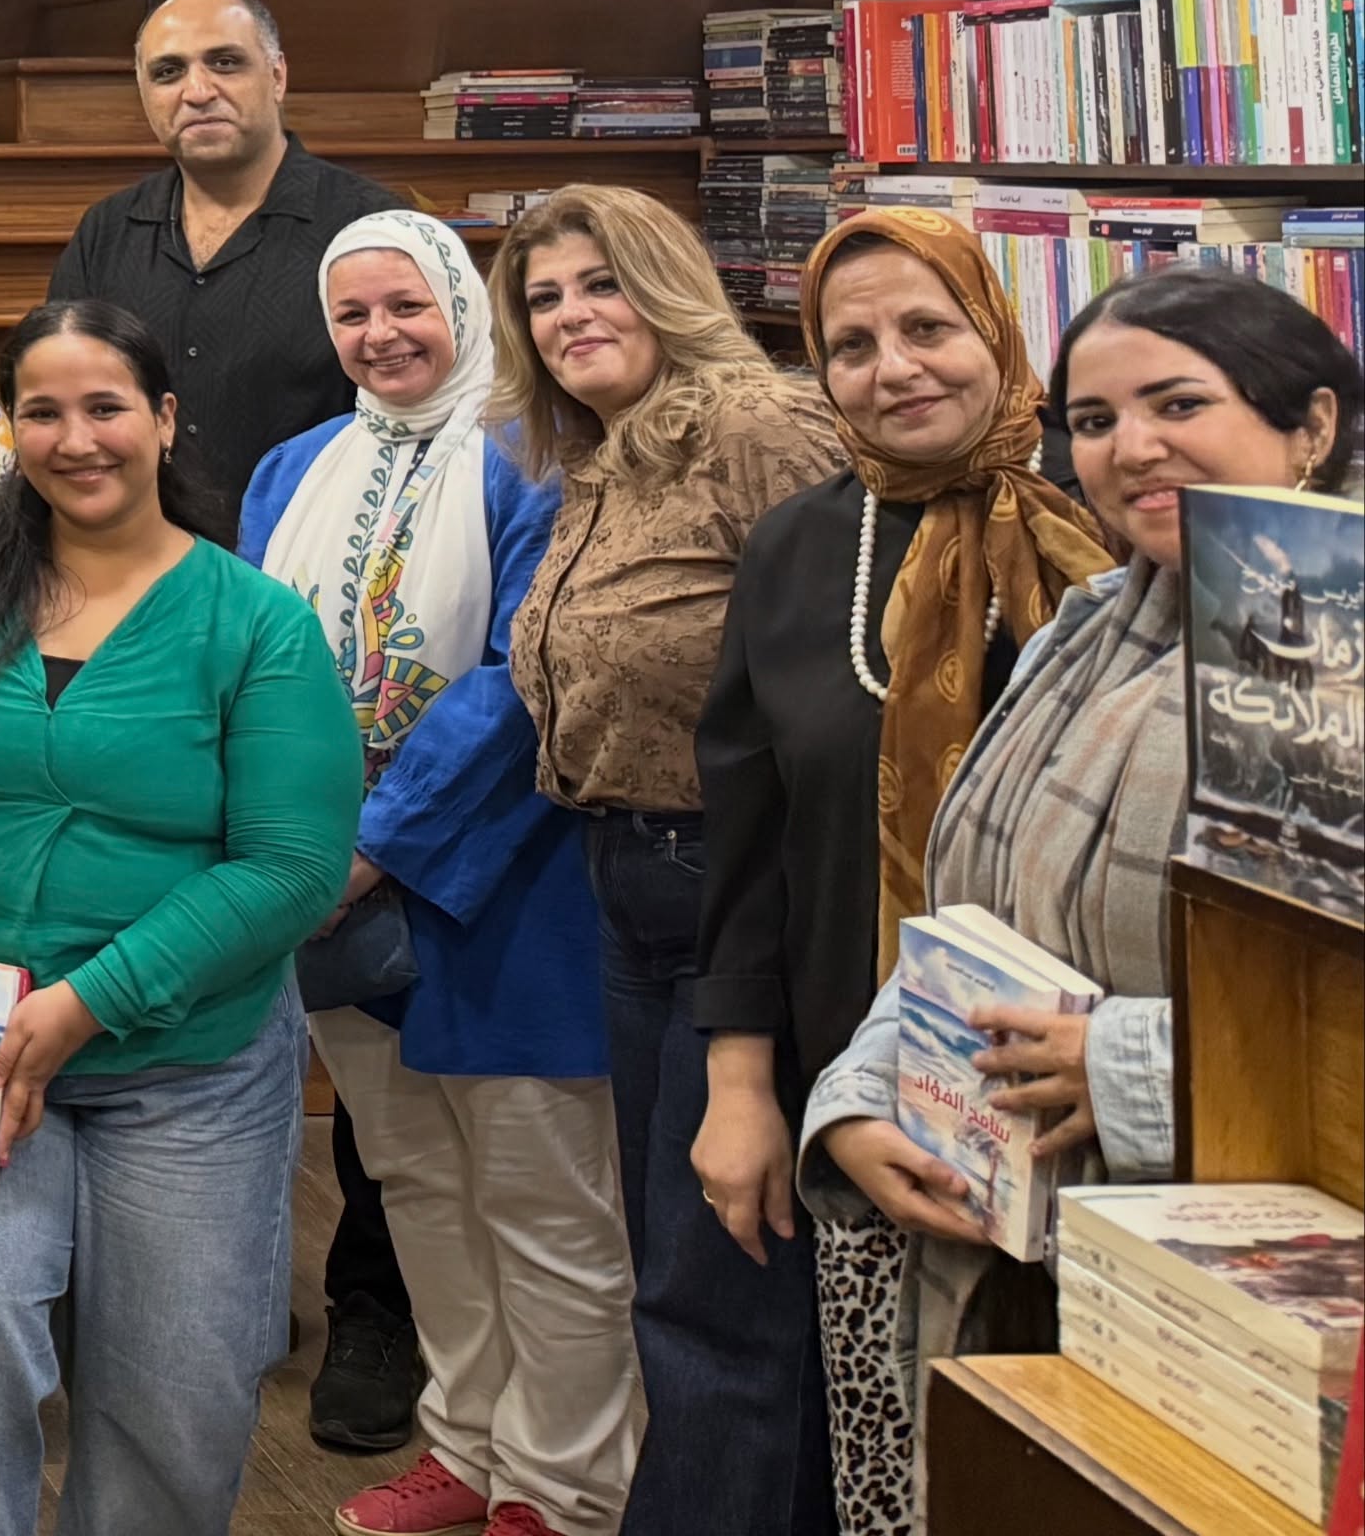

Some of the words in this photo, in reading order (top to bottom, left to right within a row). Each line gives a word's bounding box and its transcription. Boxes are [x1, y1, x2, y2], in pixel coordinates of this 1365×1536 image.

[1207, 668, 1365, 750] الملائكة
[915, 1075, 964, 1113] الفؤاد
[968, 1104, 1010, 1144] سامح
